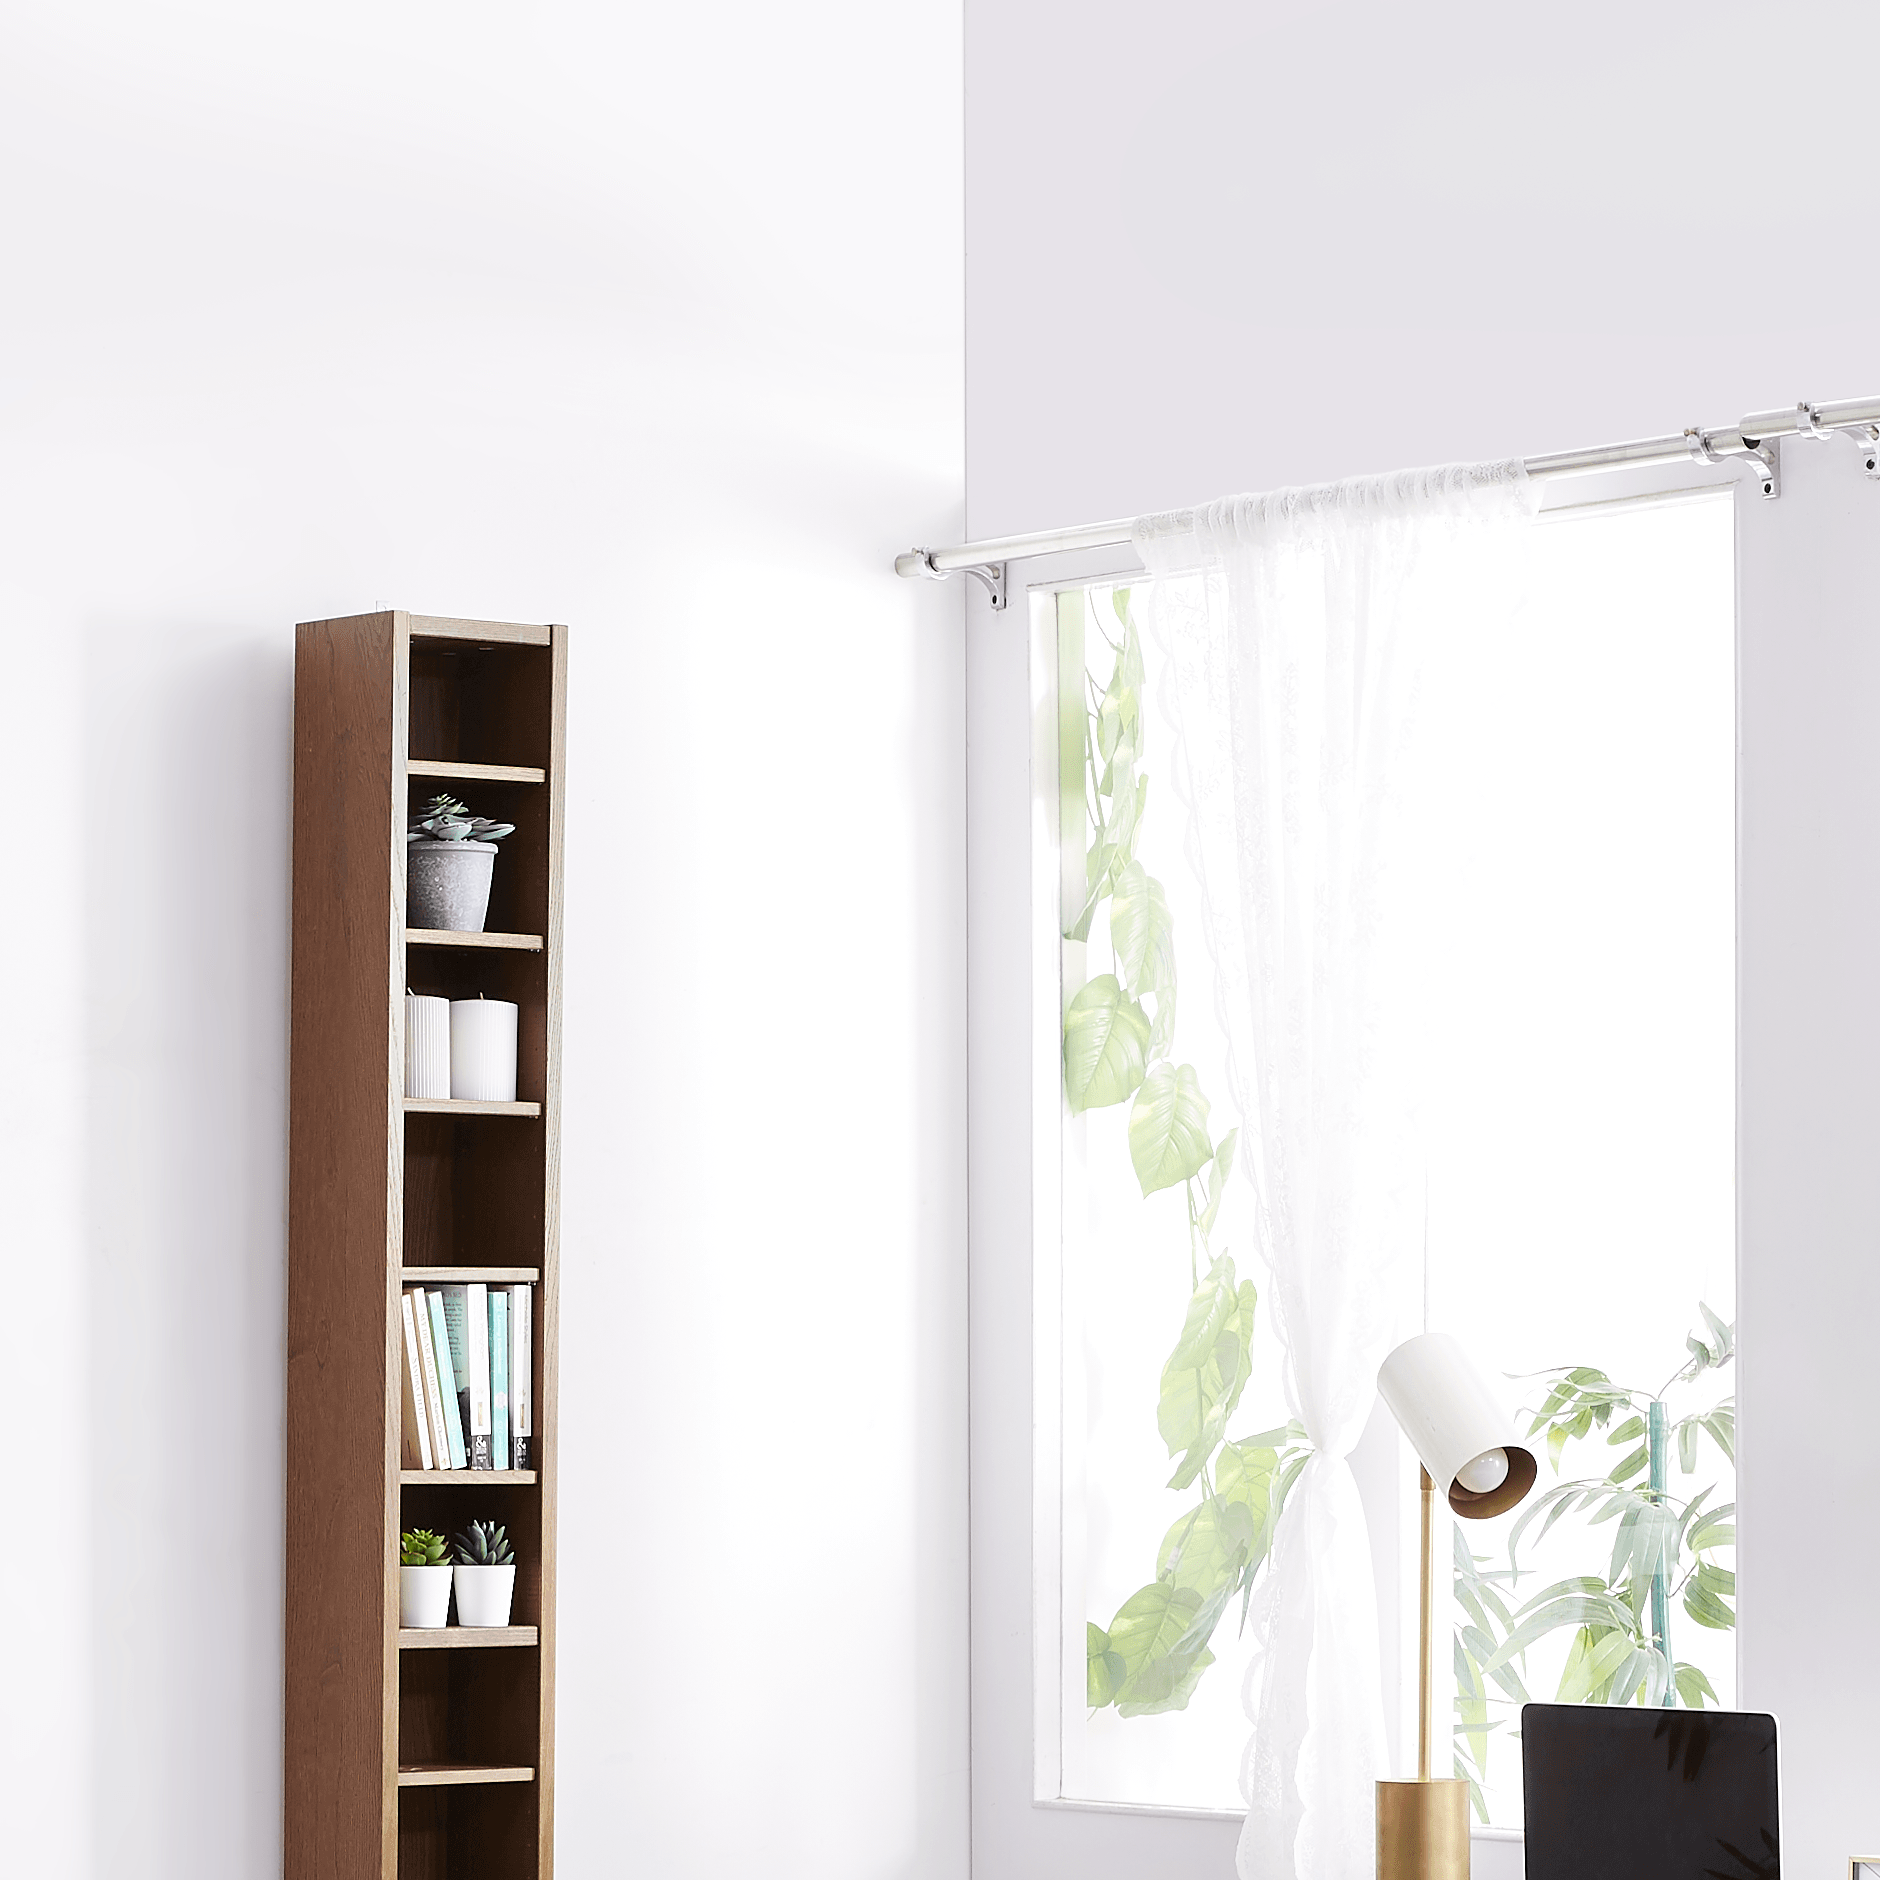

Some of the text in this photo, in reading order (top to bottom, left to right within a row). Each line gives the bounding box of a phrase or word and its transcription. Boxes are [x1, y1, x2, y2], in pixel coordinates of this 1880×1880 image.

[419, 1312, 437, 1399] MY DEAR DUCHESS
